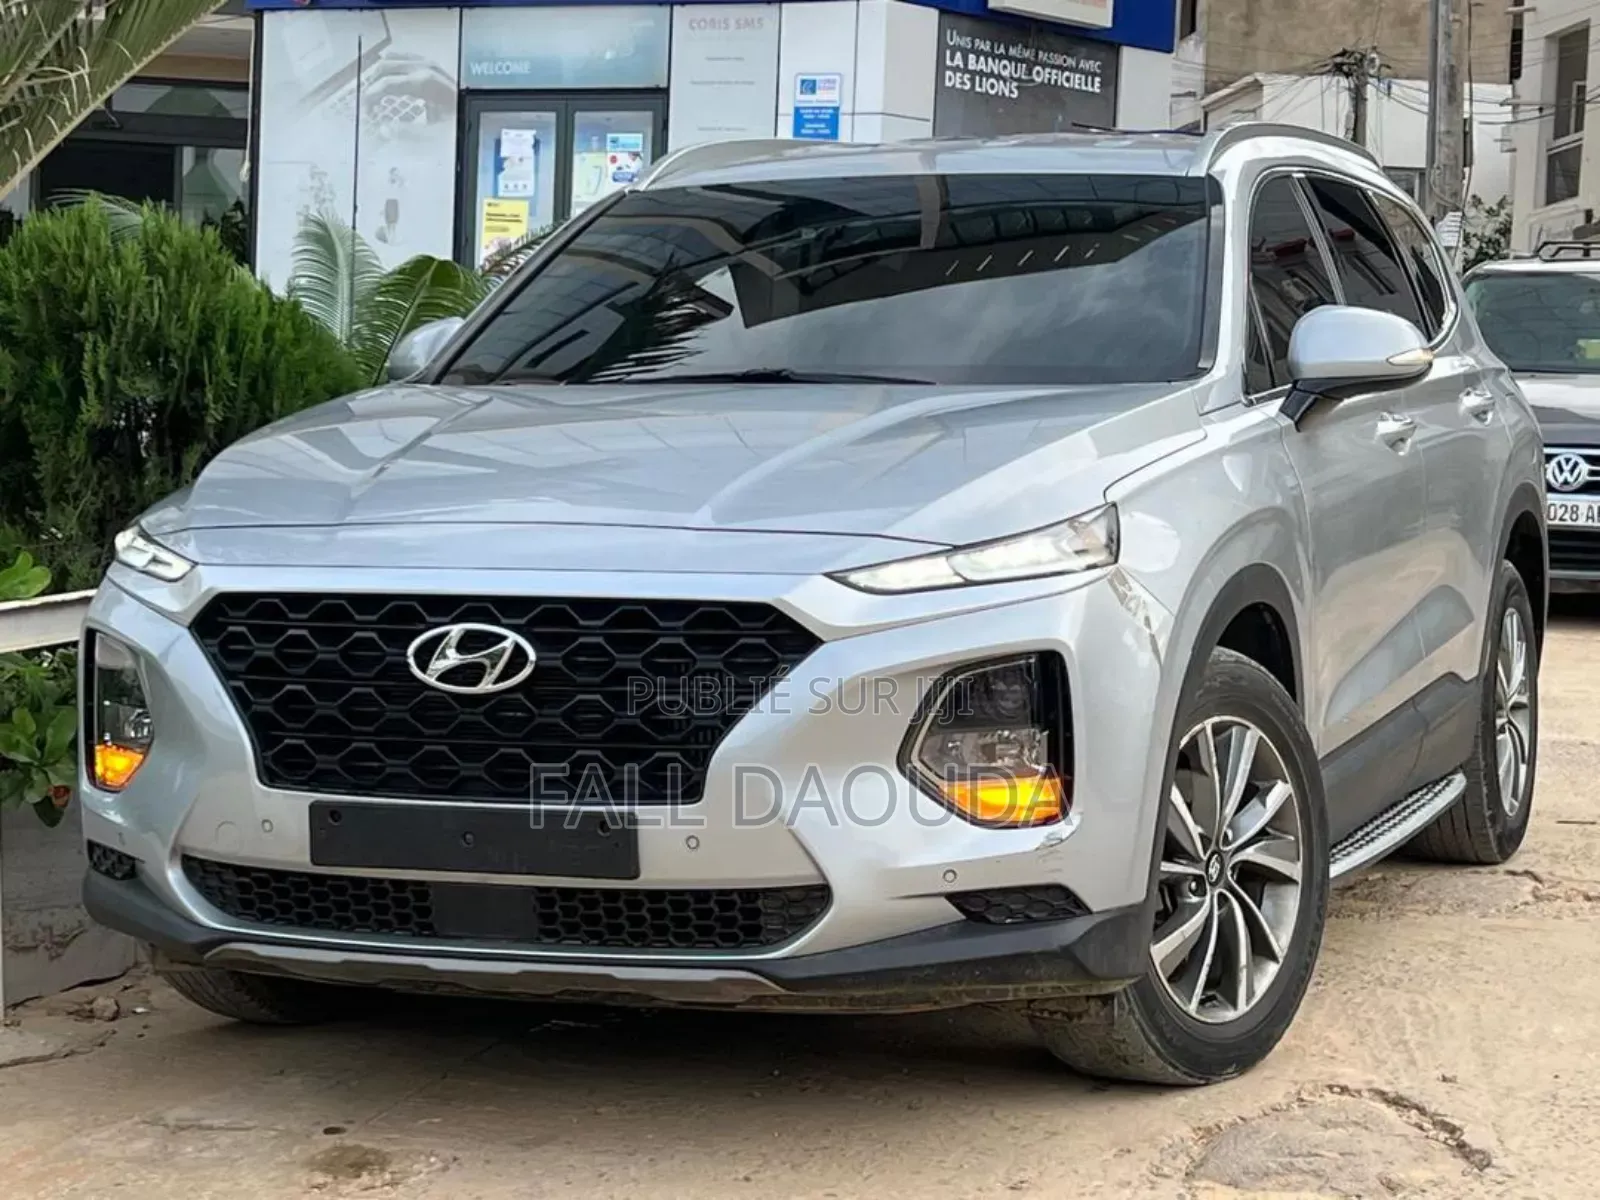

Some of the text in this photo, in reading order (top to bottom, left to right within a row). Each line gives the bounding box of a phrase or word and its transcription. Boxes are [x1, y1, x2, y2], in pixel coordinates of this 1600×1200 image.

[469, 59, 532, 77] WELCOME
[974, 38, 991, 52] PAR
[994, 42, 1006, 55] LA
[1038, 51, 1075, 67] PASSION
[1079, 59, 1102, 72] AVEC
[944, 70, 1020, 99] DES LIONS
[945, 49, 964, 69] LA
[1032, 66, 1102, 93] OFFICIELLE
[1547, 503, 1579, 522] 028
